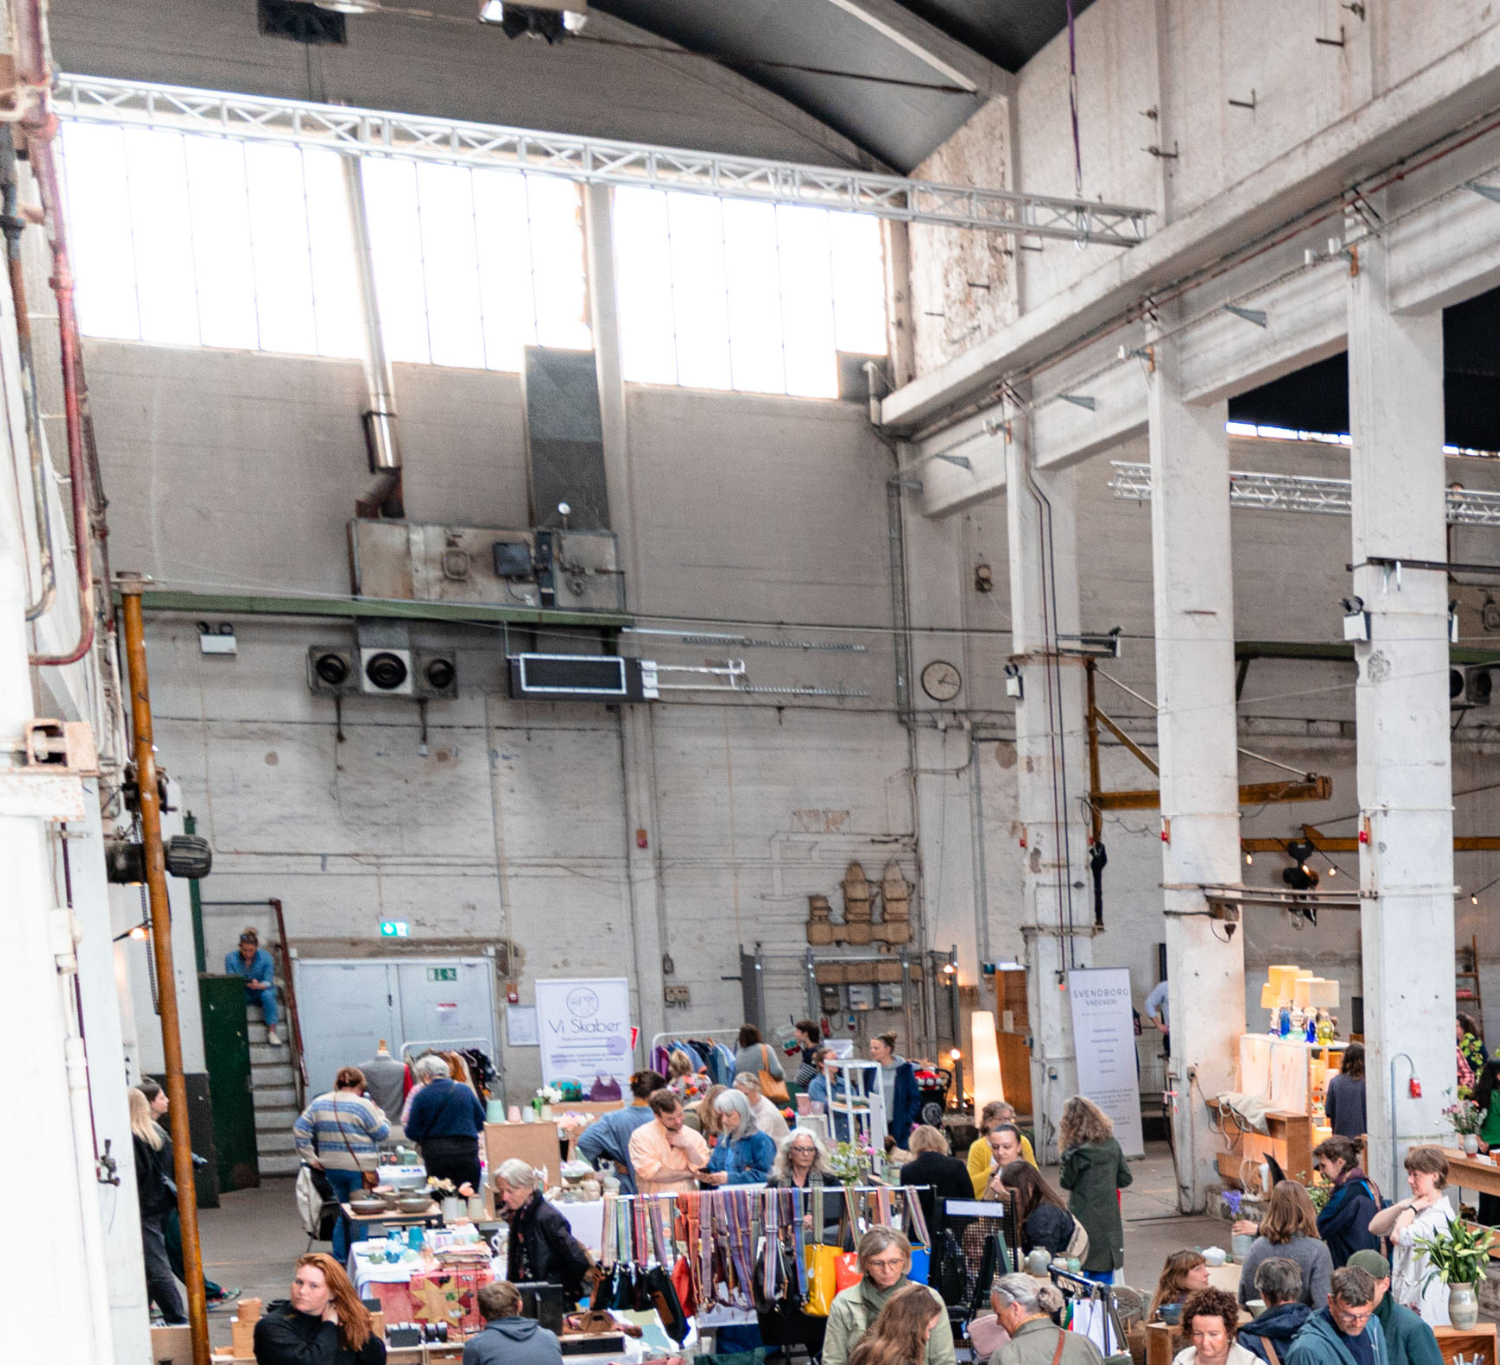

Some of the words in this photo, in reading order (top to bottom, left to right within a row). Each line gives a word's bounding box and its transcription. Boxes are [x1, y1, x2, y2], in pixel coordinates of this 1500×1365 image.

[1073, 987, 1129, 999] SVENDBORG
[548, 1019, 565, 1034] Vi
[571, 1018, 622, 1034] Skaber
